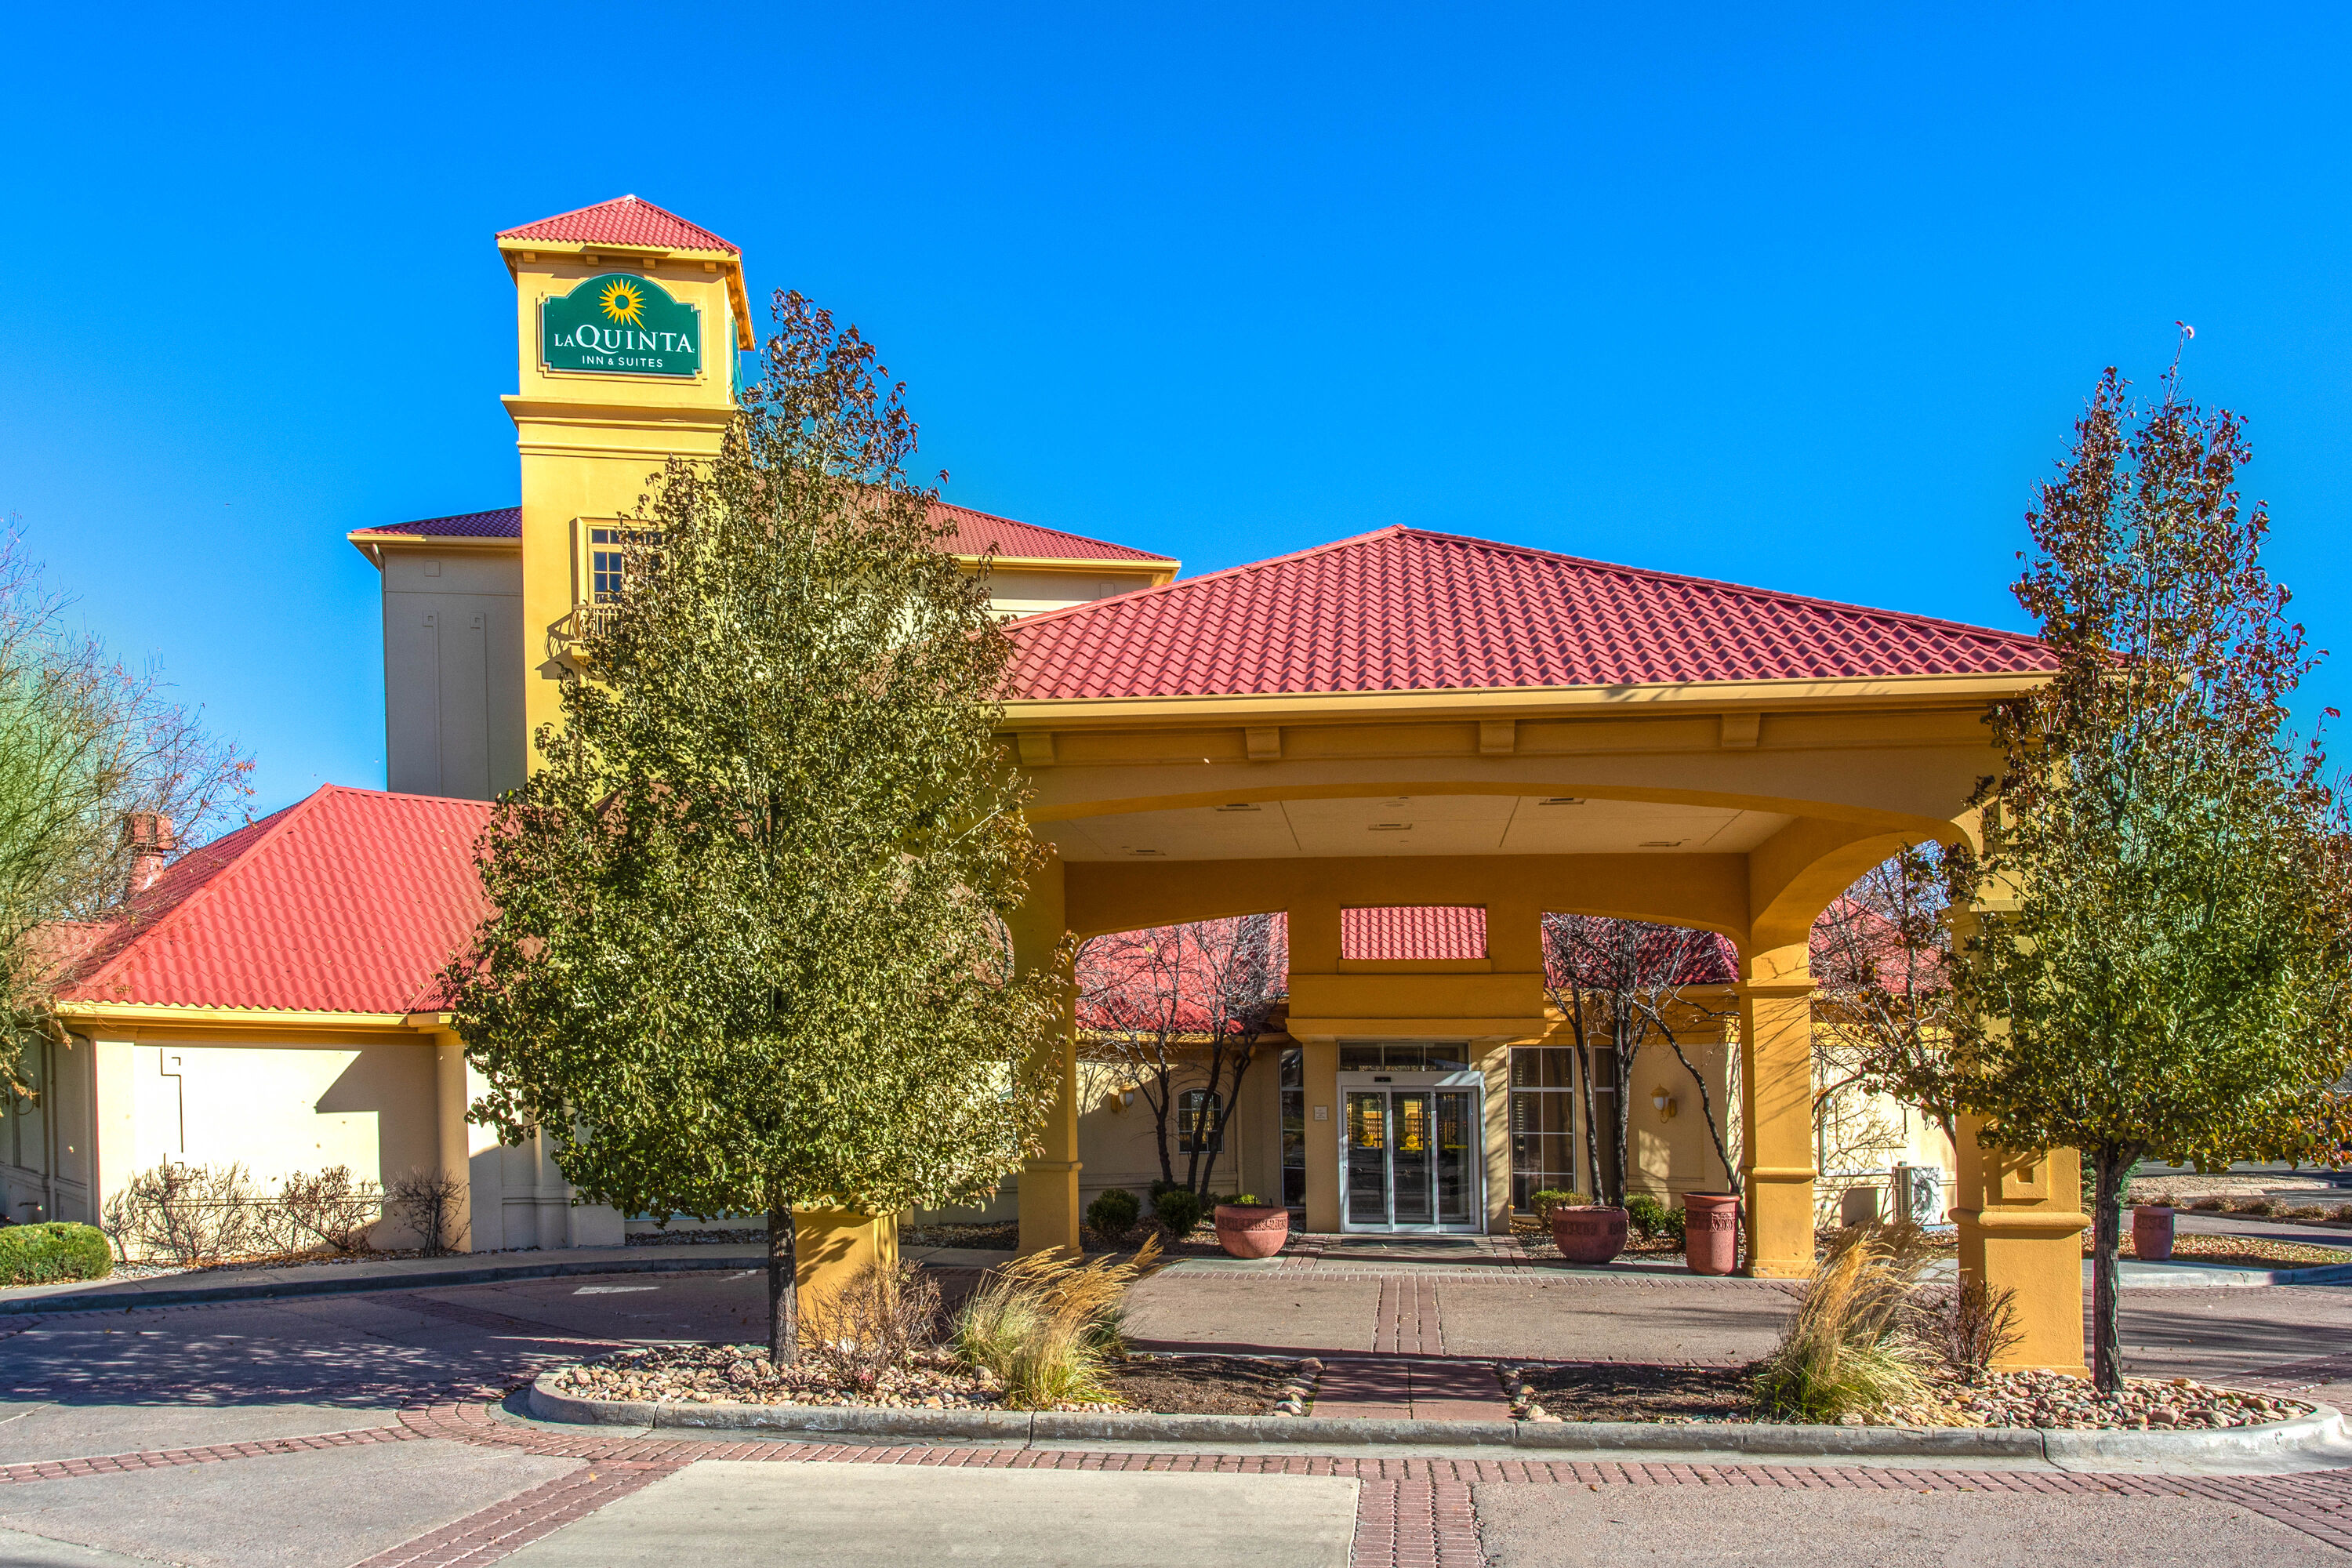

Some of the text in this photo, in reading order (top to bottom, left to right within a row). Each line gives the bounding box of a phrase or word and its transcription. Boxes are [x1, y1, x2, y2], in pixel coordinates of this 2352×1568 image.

[554, 324, 695, 354] LA QUINTA
[582, 355, 604, 365] INN
[618, 357, 663, 368] SUITES
